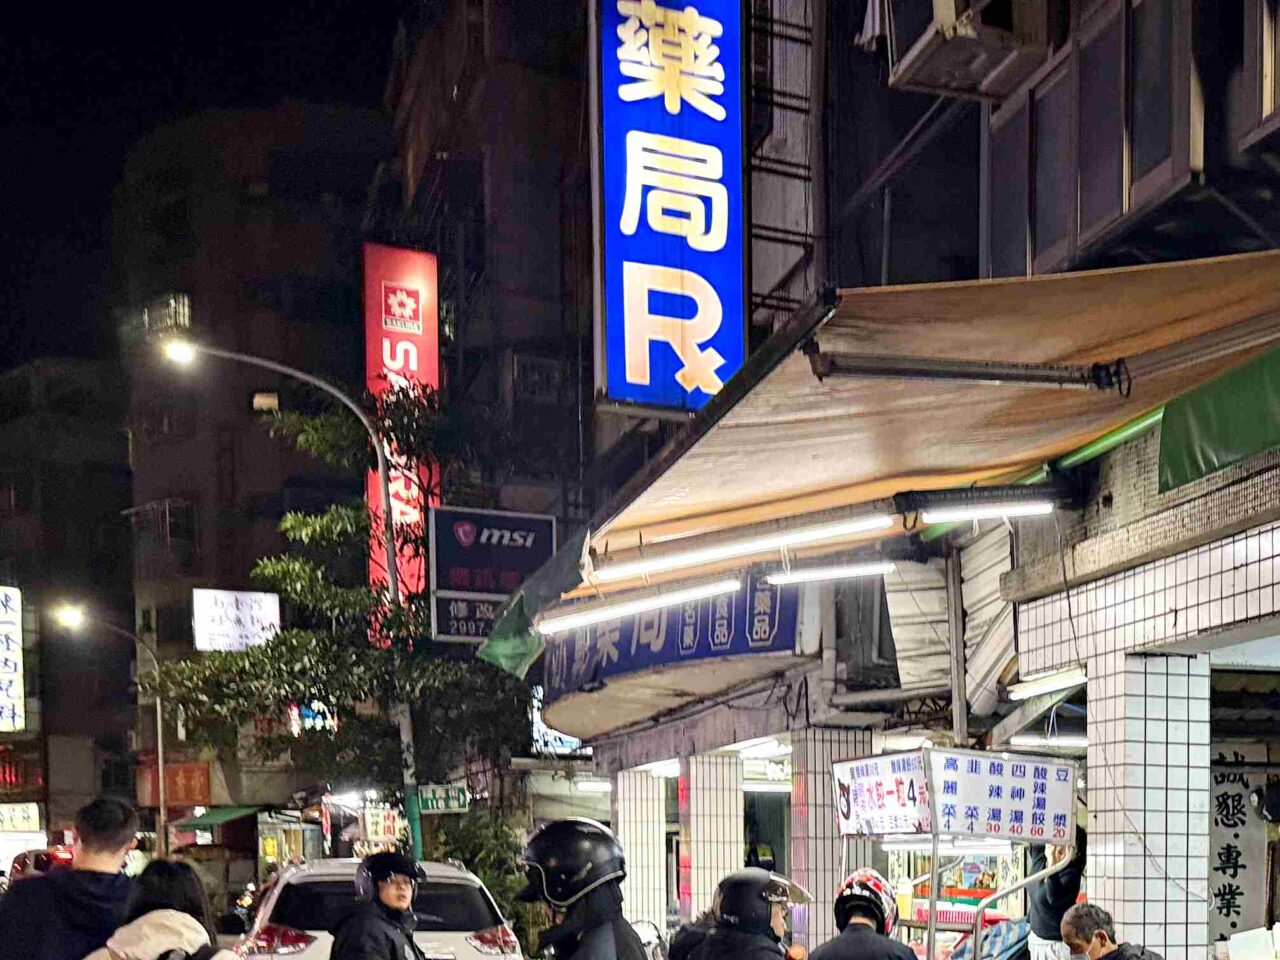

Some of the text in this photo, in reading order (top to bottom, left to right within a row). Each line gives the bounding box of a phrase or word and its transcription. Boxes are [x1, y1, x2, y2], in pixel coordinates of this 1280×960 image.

[617, 0, 728, 252] 藥局
[480, 528, 535, 548] msi
[986, 761, 1004, 833] 酸辣湯 30
[1009, 764, 1026, 824] 四神湯
[1009, 824, 1023, 835] 40
[1031, 826, 1044, 837] 60
[1053, 828, 1066, 839] 20
